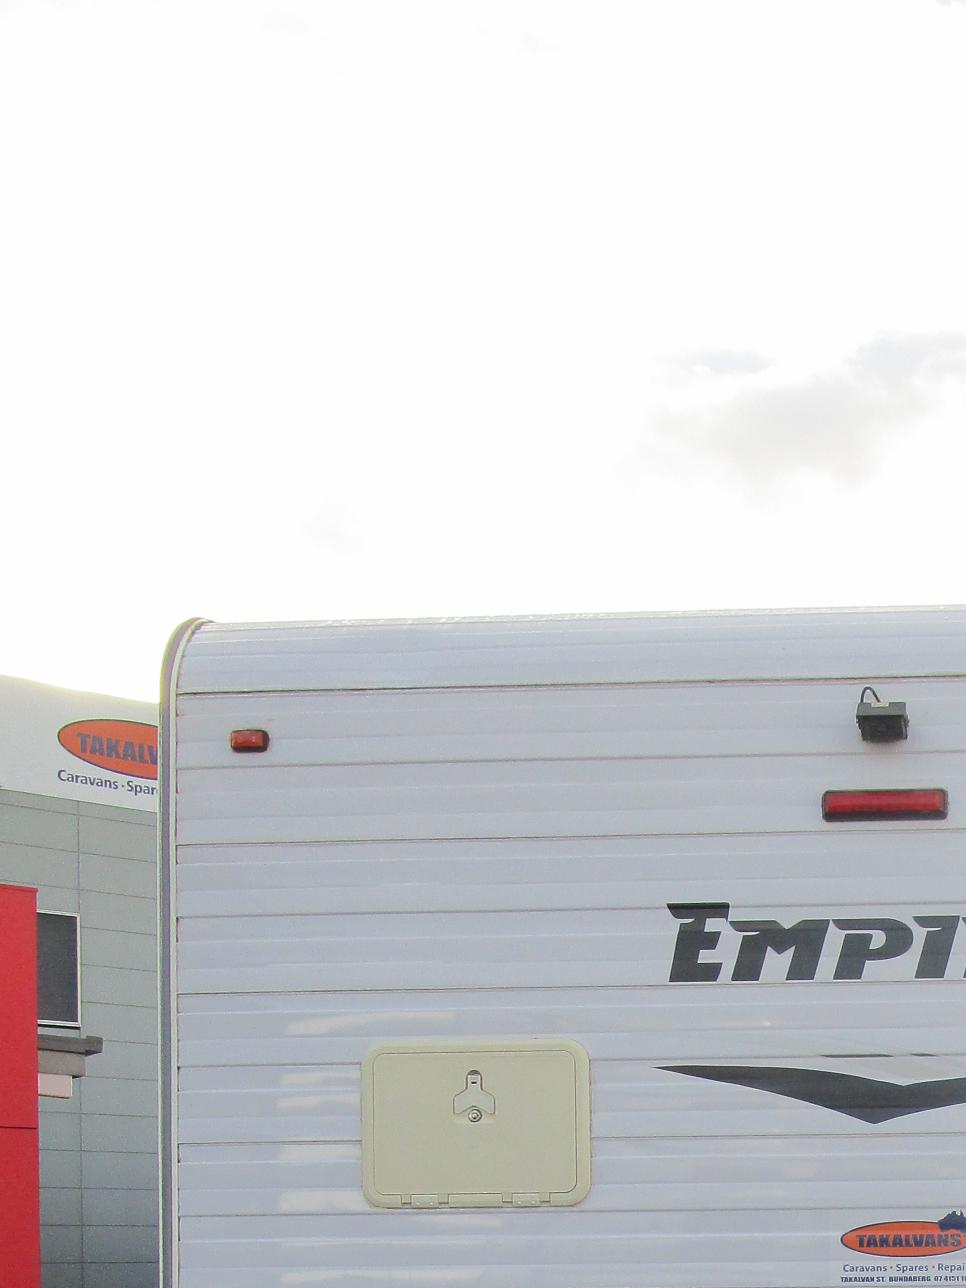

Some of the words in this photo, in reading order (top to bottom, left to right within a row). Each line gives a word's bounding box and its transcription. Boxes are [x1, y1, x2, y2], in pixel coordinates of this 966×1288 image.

[57, 769, 119, 790] Caravans
[126, 780, 158, 796] Spar
[856, 1233, 961, 1248] TAKALVANS
[843, 1263, 887, 1273] Caravans
[896, 1263, 929, 1273] Spares
